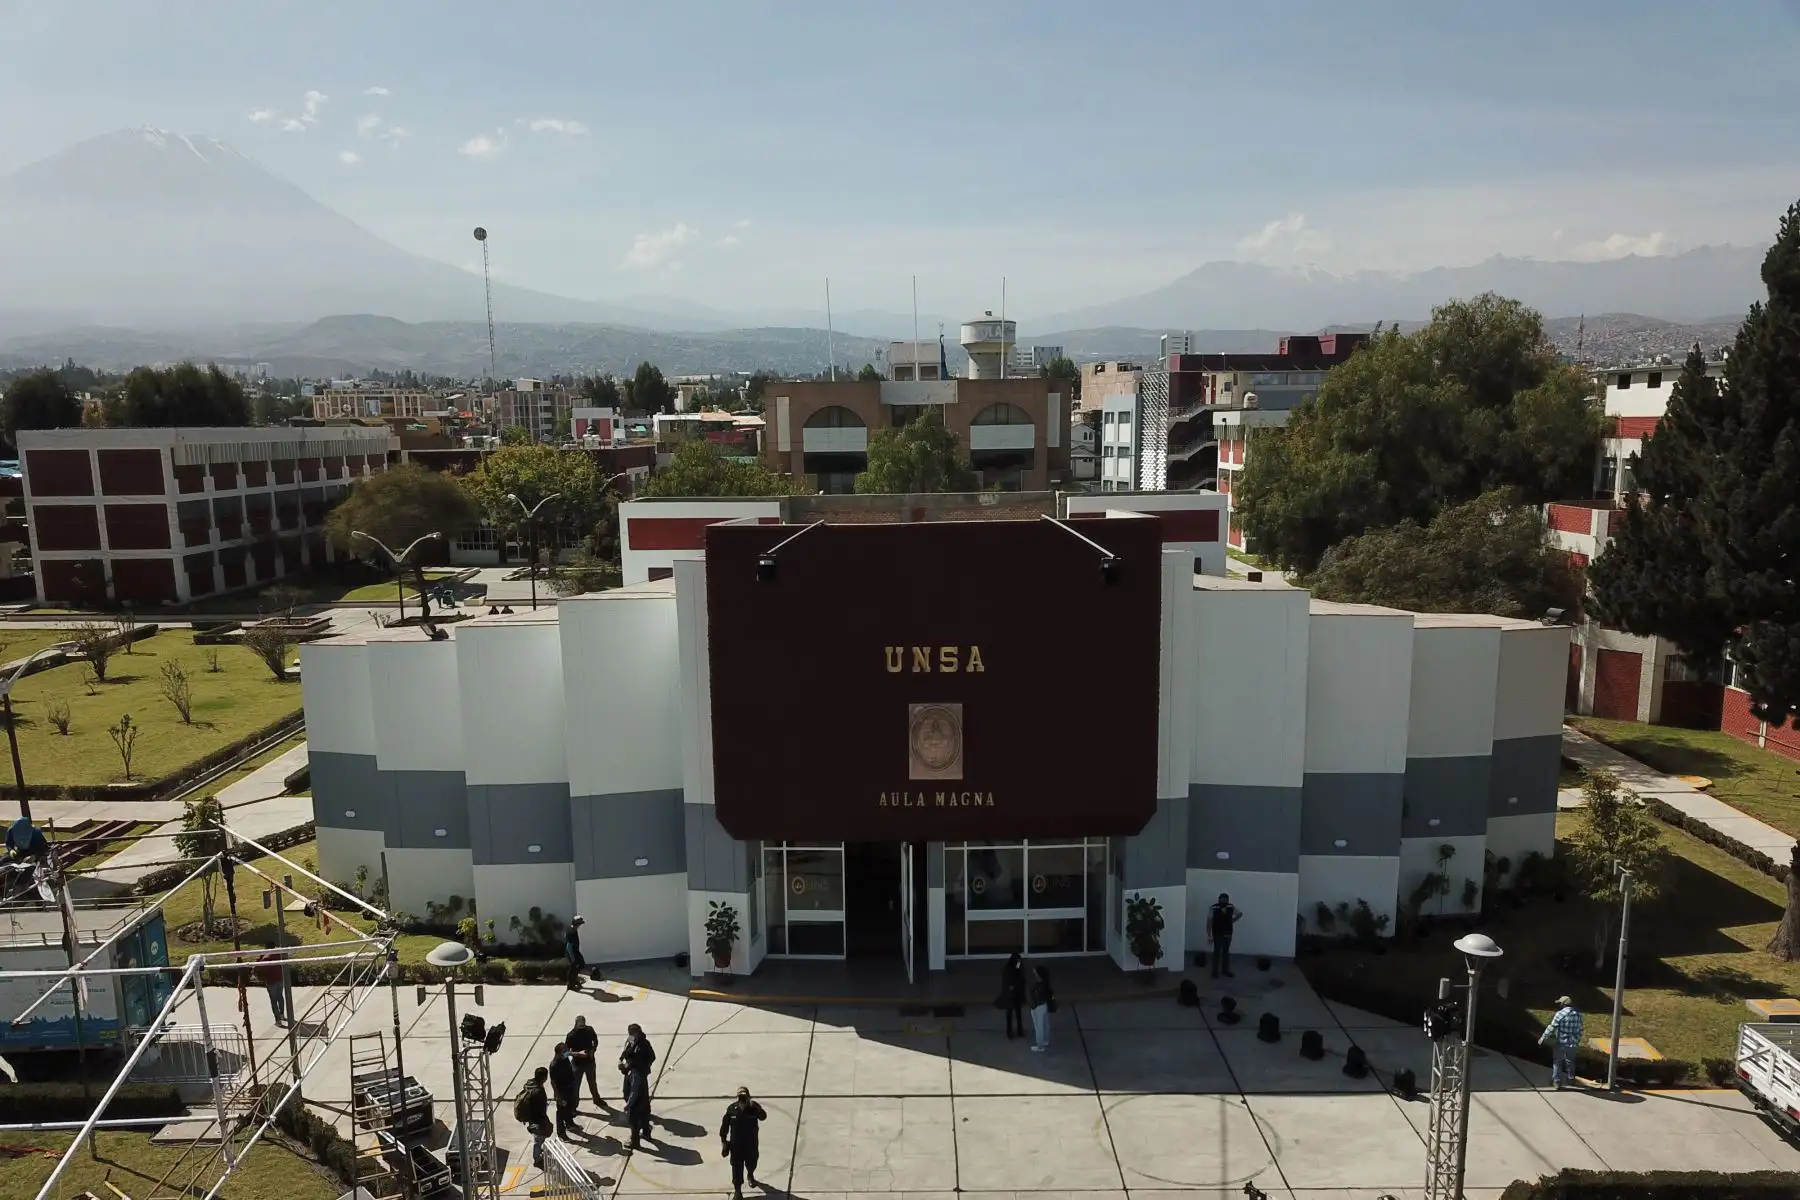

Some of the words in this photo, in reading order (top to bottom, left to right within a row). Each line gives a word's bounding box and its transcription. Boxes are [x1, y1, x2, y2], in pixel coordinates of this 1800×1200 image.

[885, 645, 985, 673] UNSA
[880, 791, 925, 806] AULA
[935, 791, 995, 806] MAGNA
